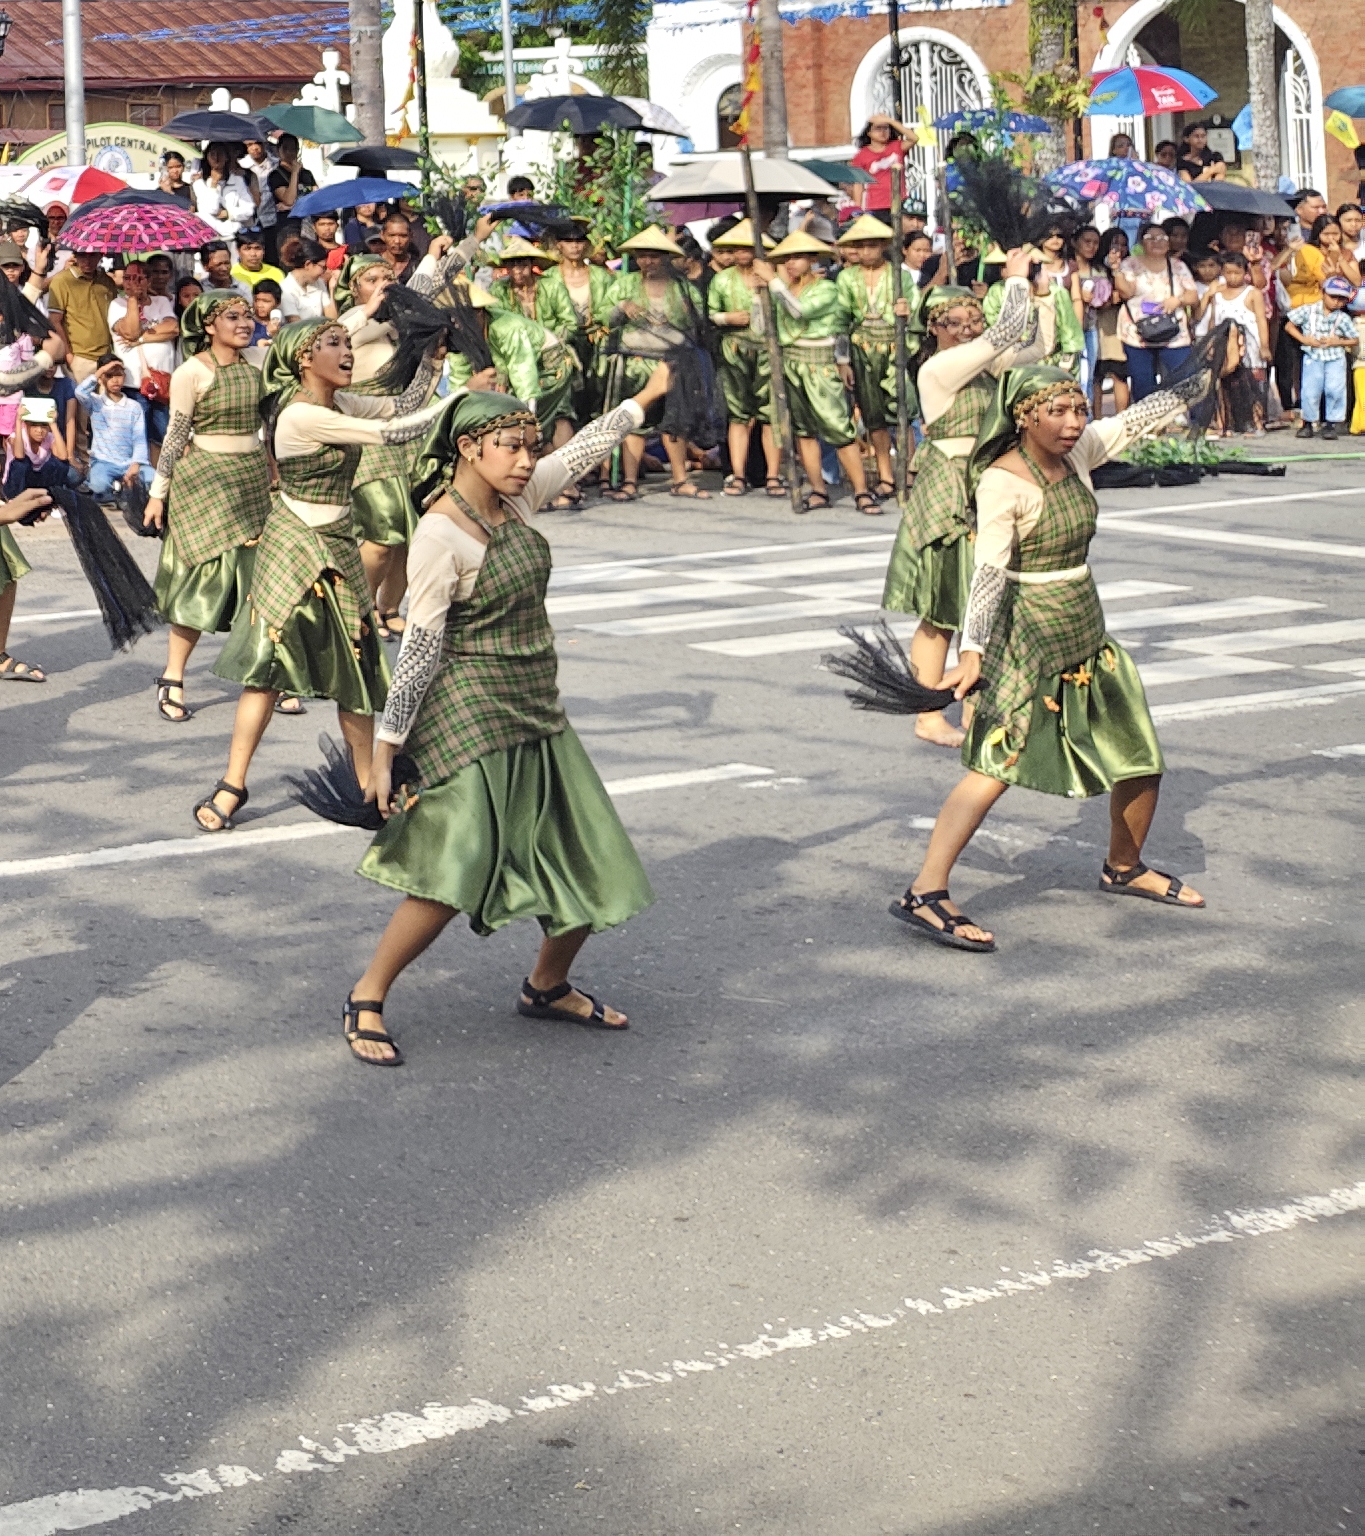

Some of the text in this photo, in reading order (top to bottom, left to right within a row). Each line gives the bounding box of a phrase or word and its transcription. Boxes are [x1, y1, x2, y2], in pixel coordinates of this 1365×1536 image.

[35, 136, 157, 171] CALBA PILOT CENTRAL
